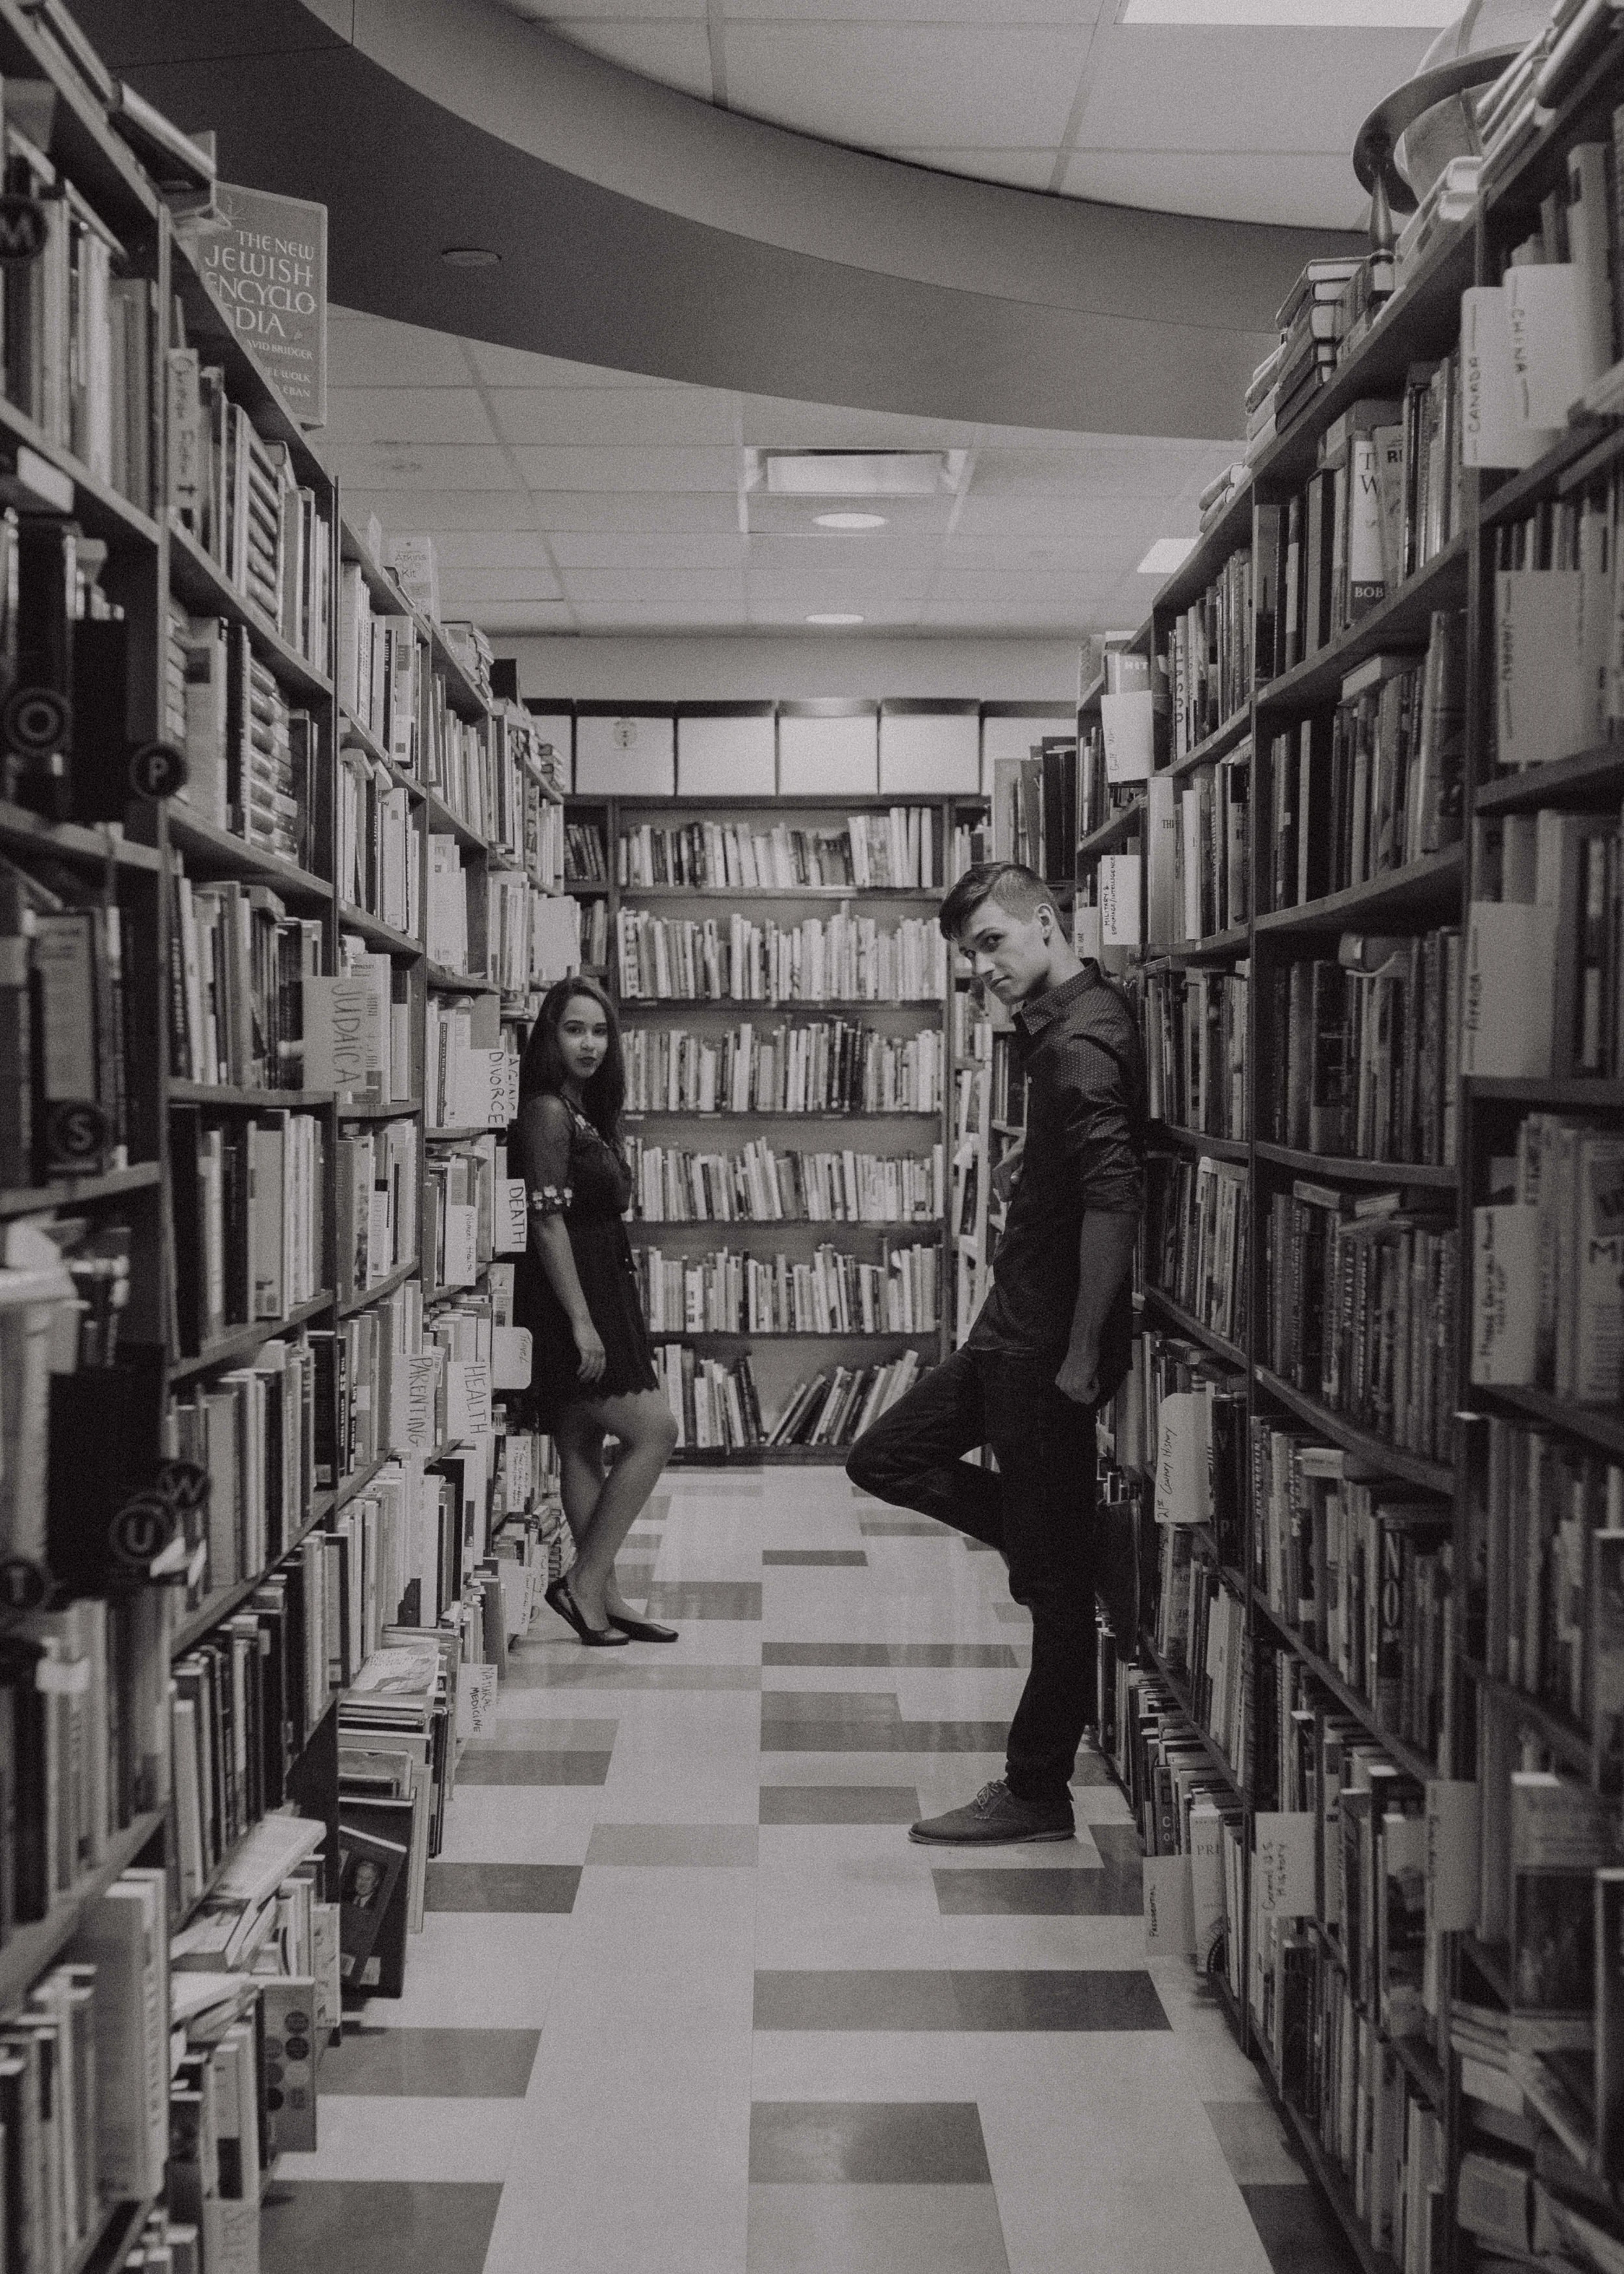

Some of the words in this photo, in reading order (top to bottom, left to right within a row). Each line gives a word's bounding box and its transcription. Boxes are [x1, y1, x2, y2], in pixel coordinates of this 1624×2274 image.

[205, 245, 313, 287] JEWISH
[237, 230, 271, 252] THE
[275, 238, 314, 261] NEW
[223, 302, 286, 338] DIA
[1512, 308, 1529, 374] CHINA
[272, 344, 313, 361] BRIDGER
[281, 370, 311, 383] WOLK
[283, 385, 311, 398] EBAN
[1468, 357, 1481, 433] CANADA
[1354, 586, 1384, 598] BOB
[331, 983, 362, 1084] JUDAICA
[488, 1051, 505, 1124] DIVORCE
[509, 1186, 525, 1244] DEATH
[407, 1357, 433, 1448] PARENTING
[464, 1366, 488, 1435] HEALTH
[470, 1687, 483, 1733] MEDICINE
[479, 1667, 494, 1711] NATURAL
